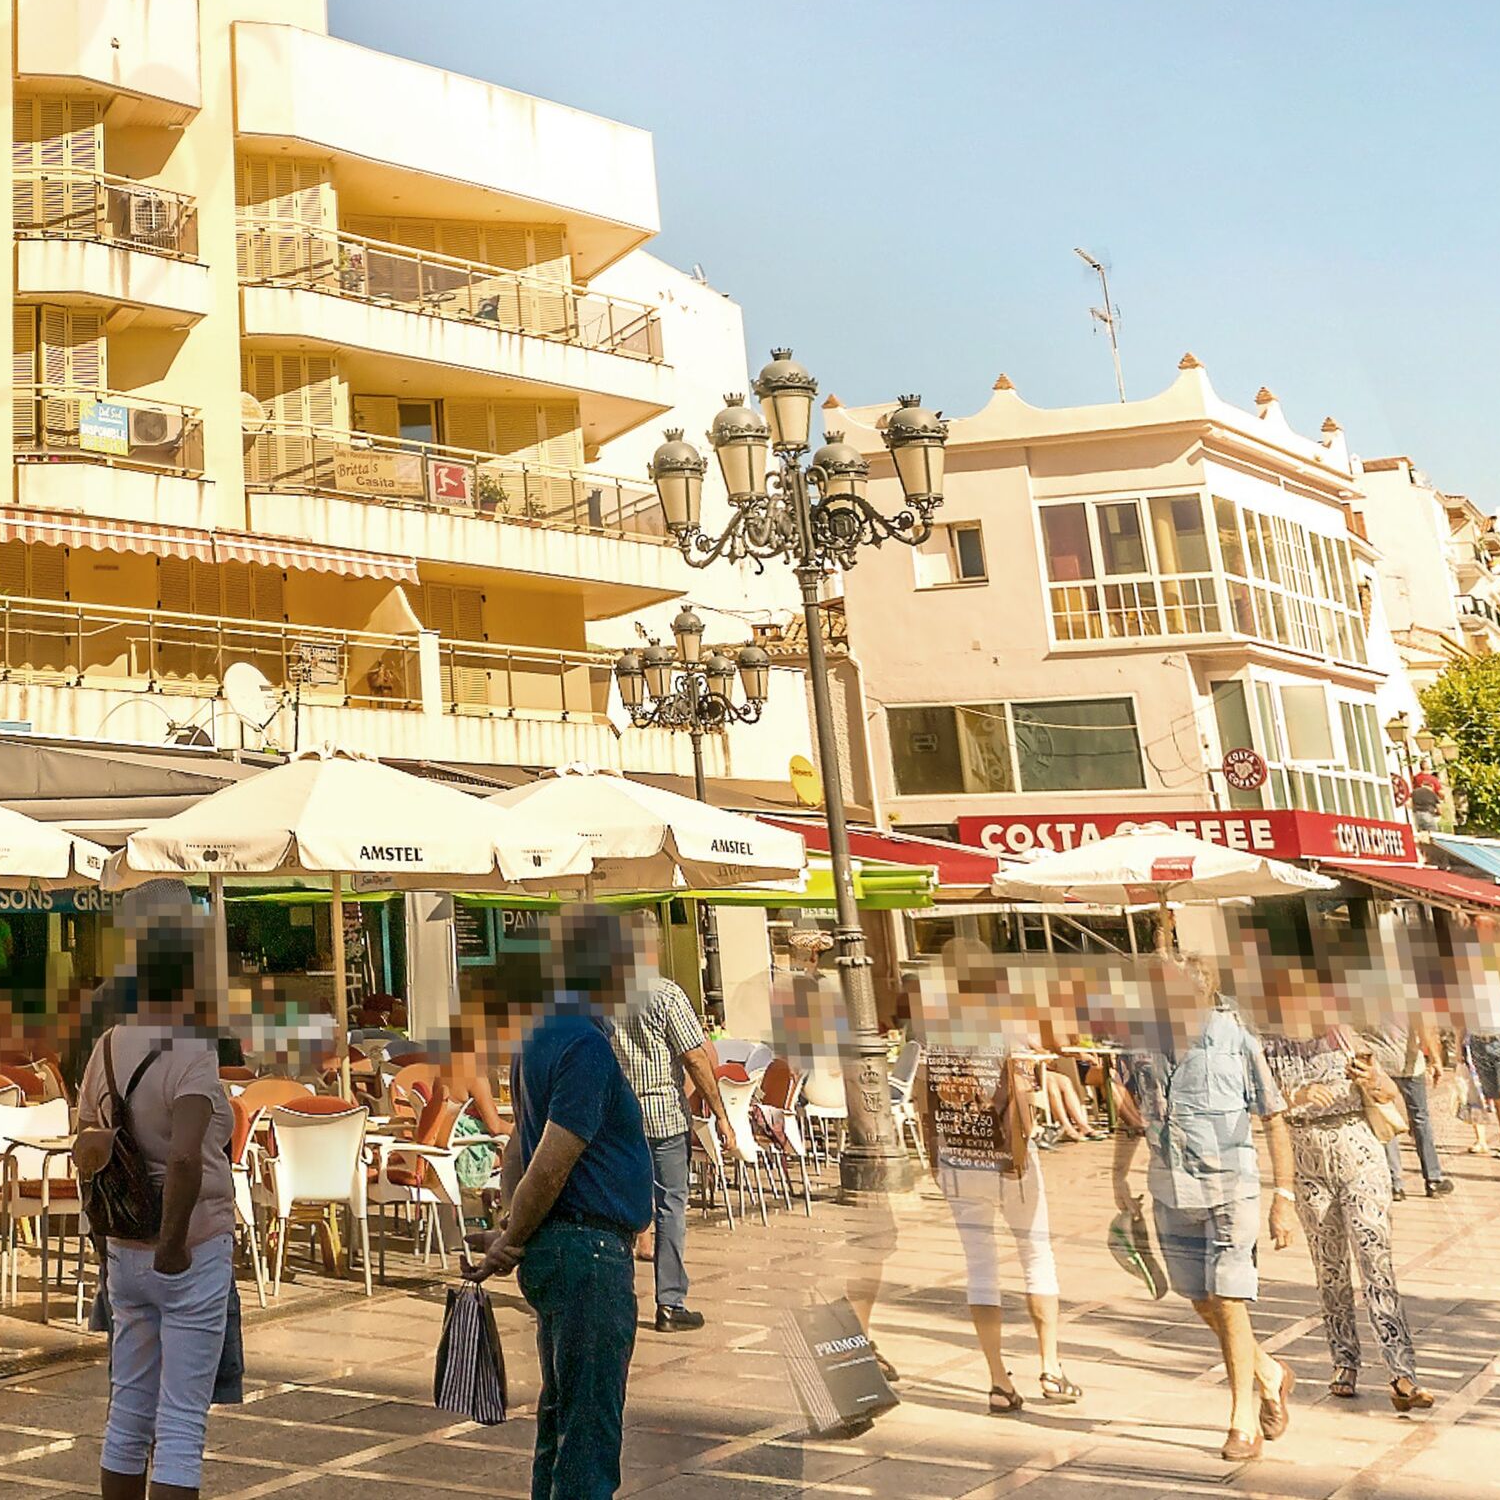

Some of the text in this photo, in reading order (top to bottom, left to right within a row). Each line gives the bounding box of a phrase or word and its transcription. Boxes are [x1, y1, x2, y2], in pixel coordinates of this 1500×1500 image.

[711, 839, 754, 856] AMSTEL
[980, 822, 1098, 854] COSTA
[1337, 822, 1407, 857] COSTA COFFEE
[359, 845, 424, 862] AMSTEL
